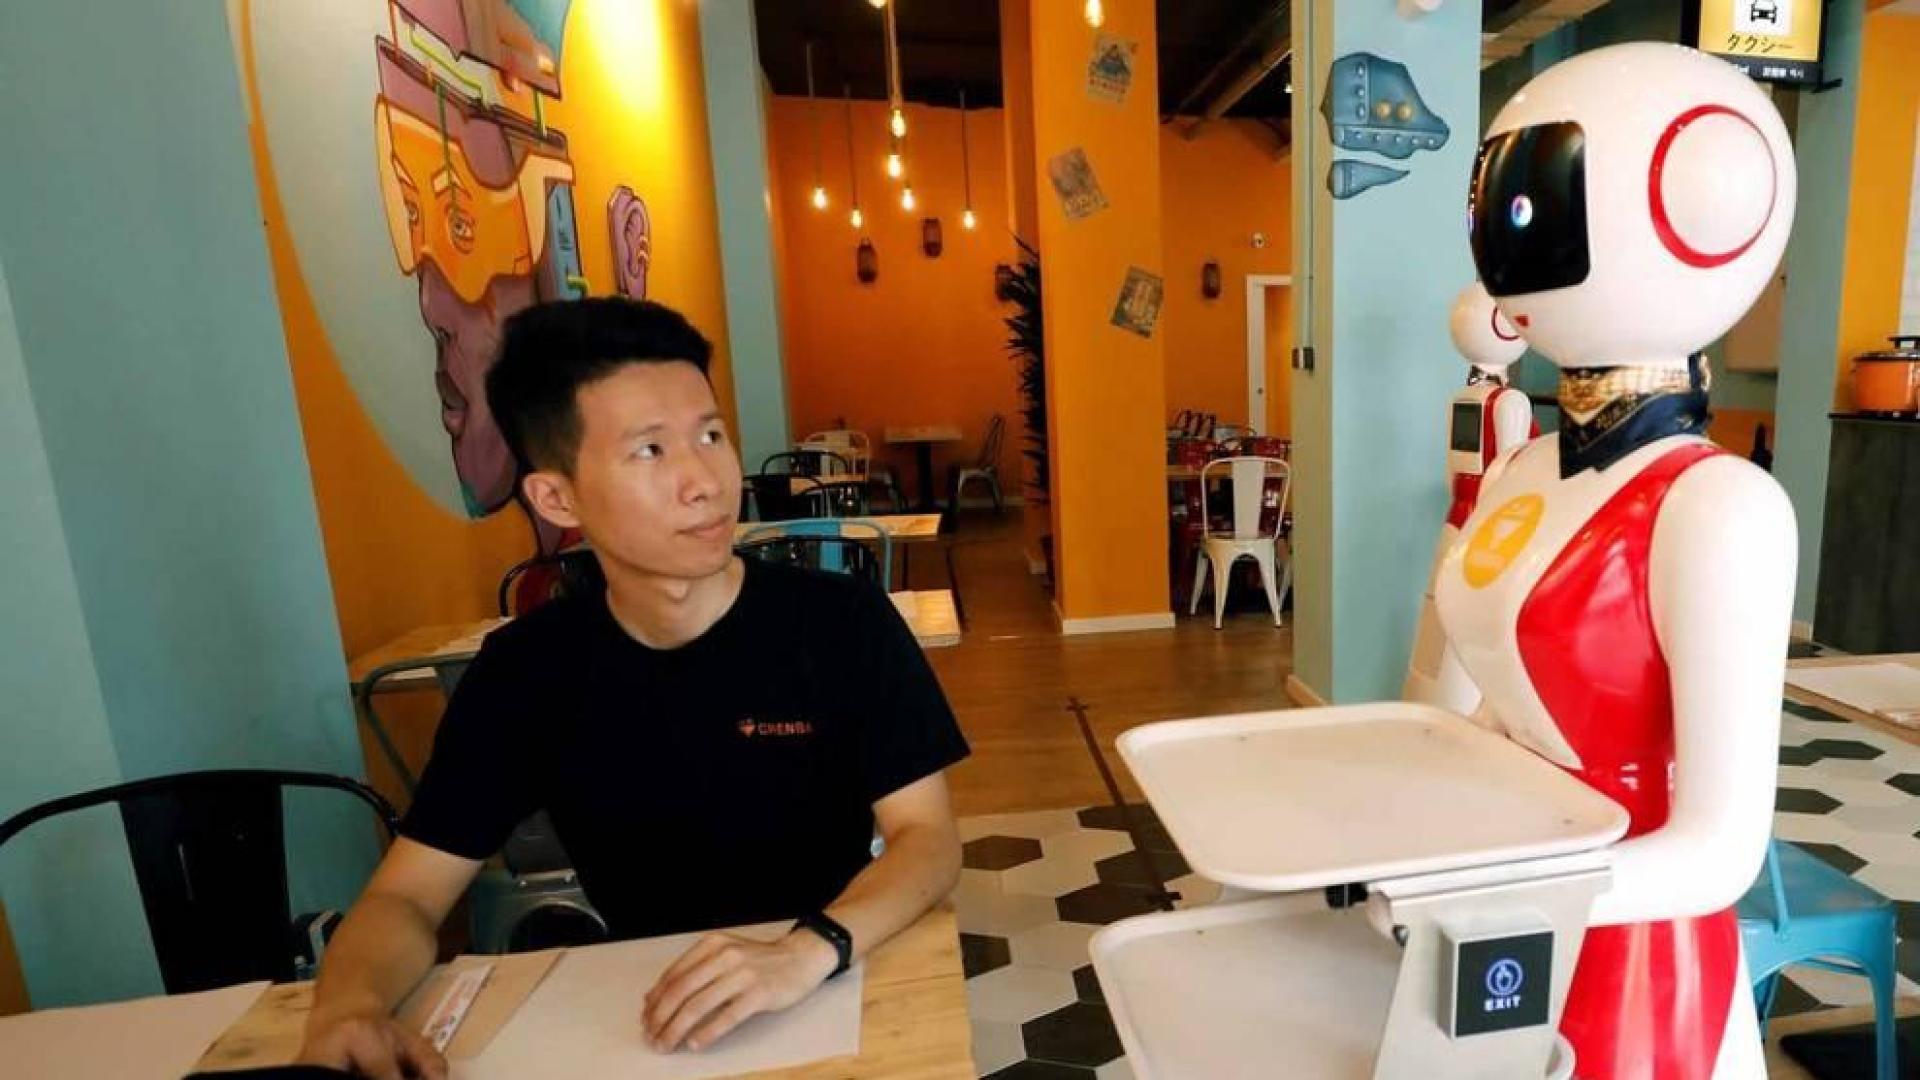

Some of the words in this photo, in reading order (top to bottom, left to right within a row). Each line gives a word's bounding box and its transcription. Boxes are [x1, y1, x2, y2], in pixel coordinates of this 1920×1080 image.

[1727, 34, 1793, 53] タクシー
[1484, 995, 1521, 1012] EXIT
